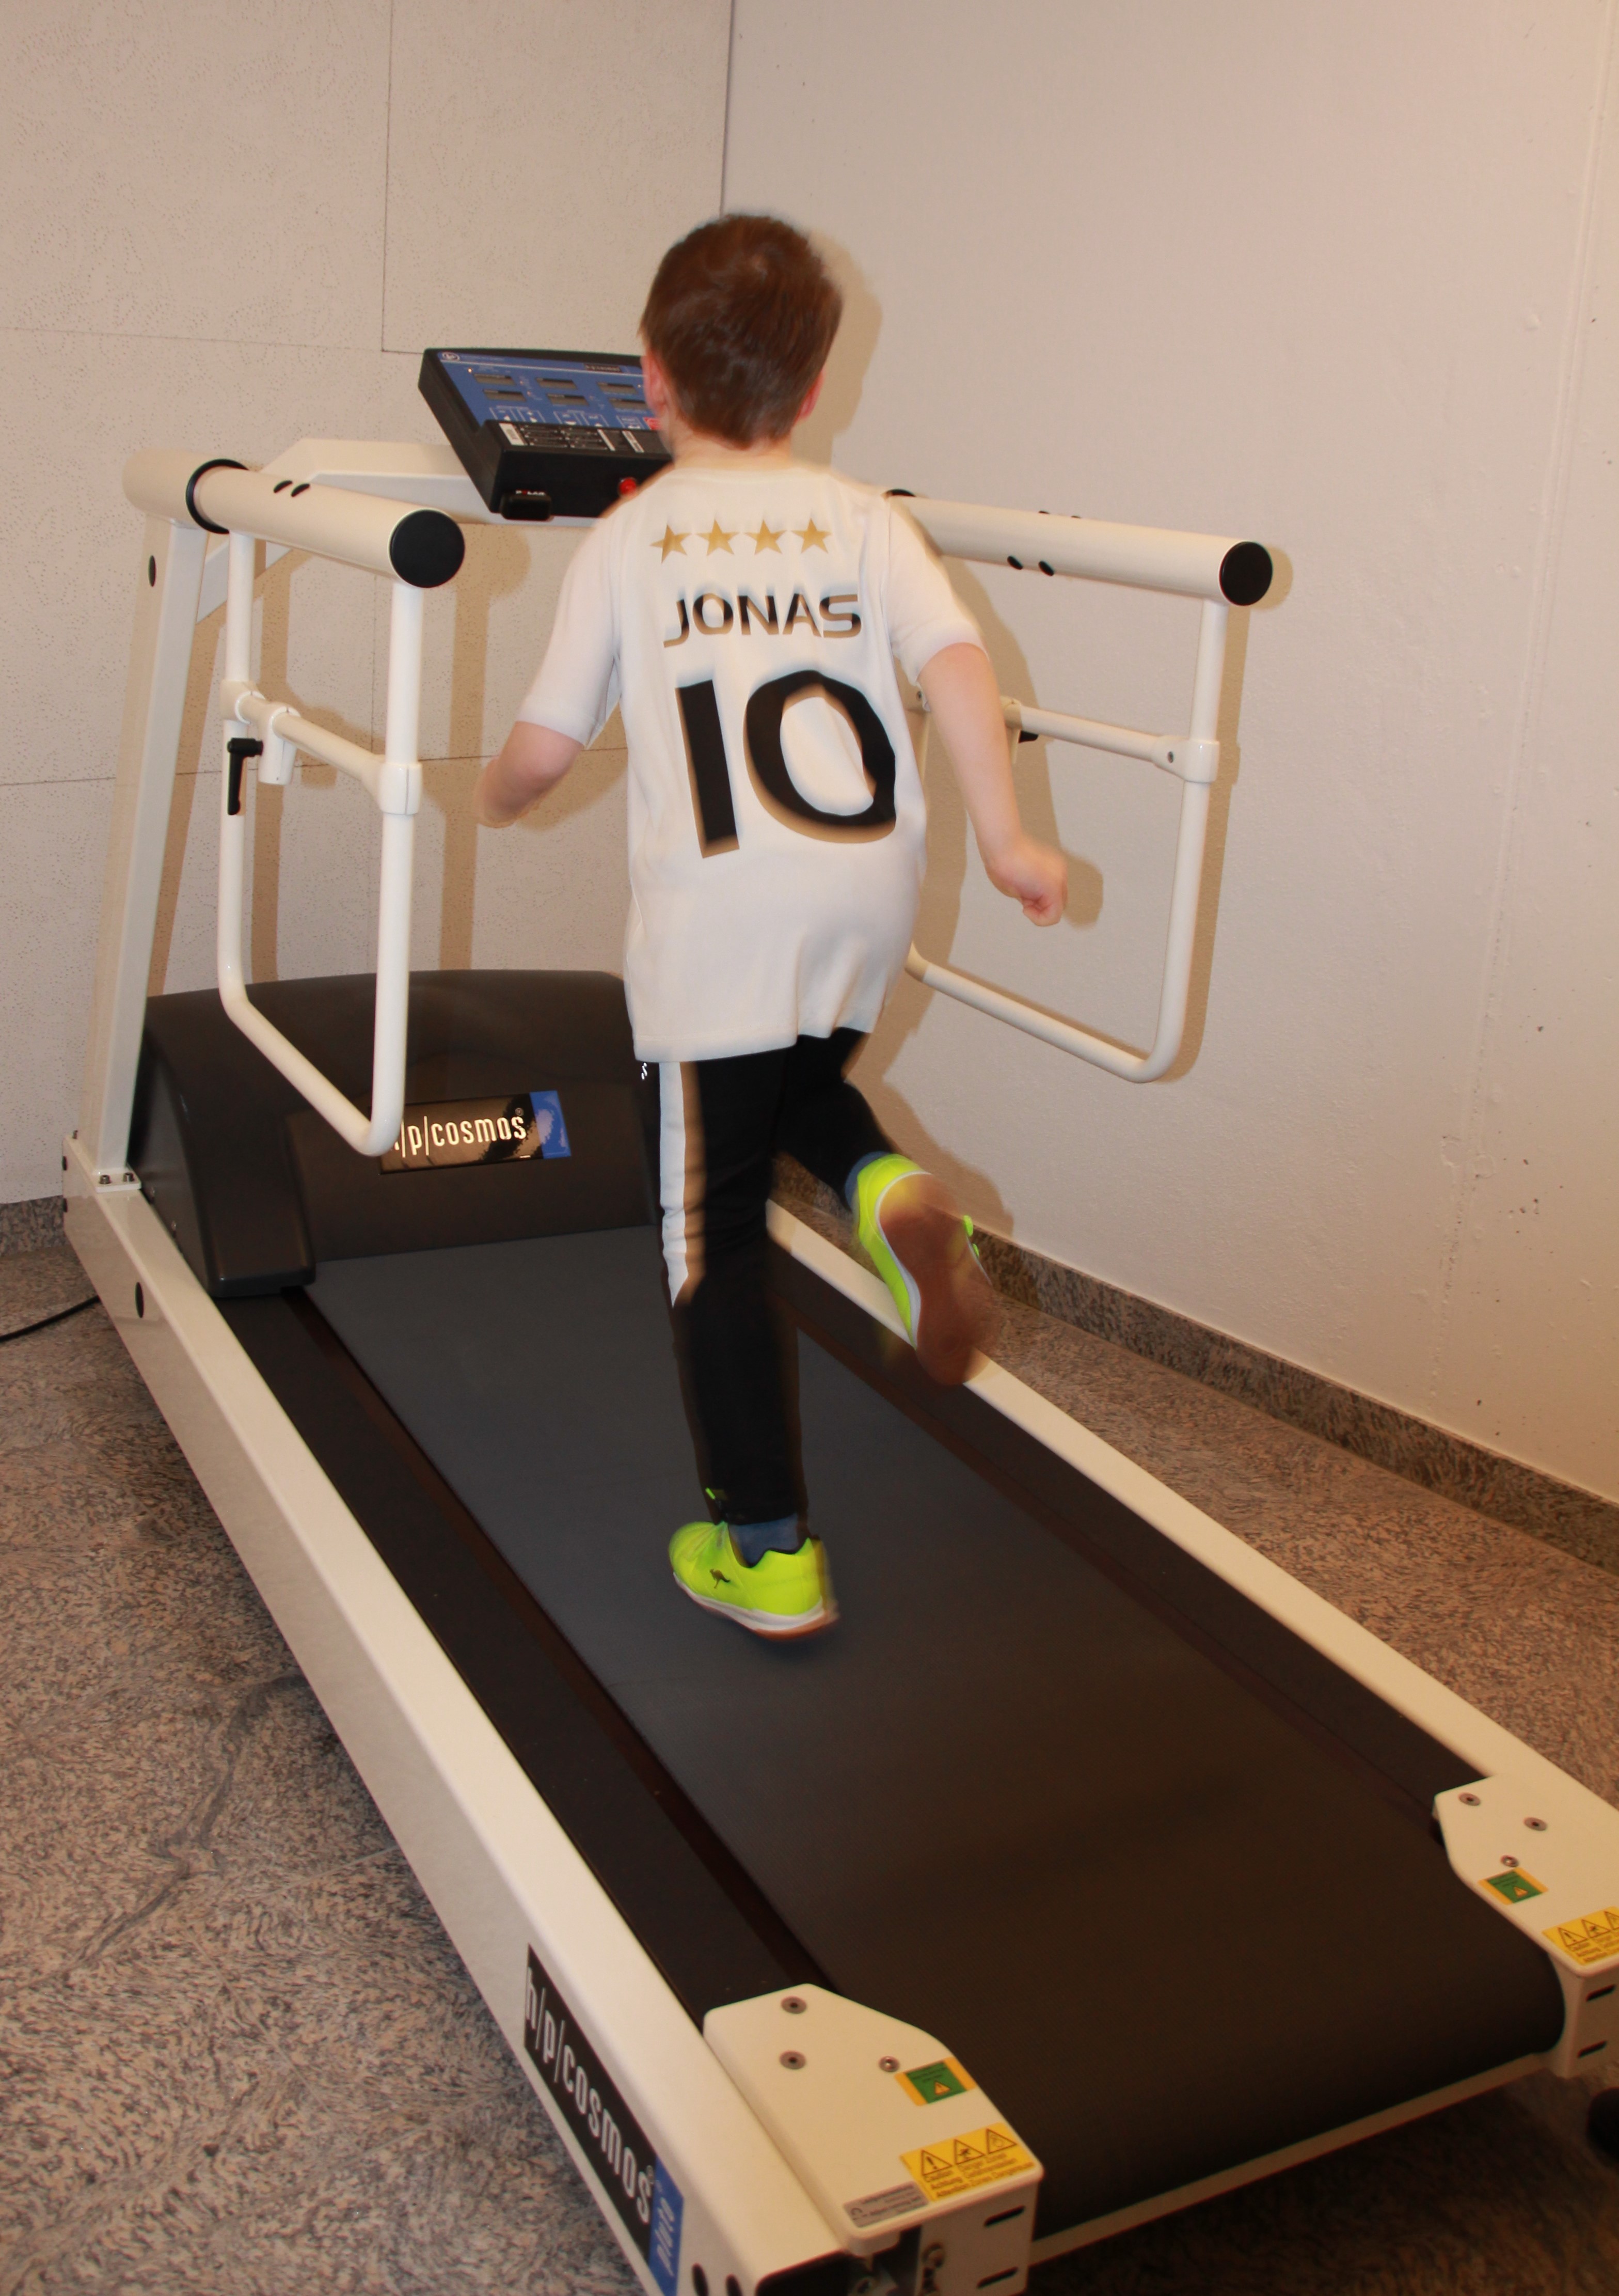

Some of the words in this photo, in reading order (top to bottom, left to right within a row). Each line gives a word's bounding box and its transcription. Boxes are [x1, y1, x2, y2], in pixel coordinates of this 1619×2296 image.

[663, 592, 862, 649] JONAS
[674, 669, 897, 859] 10
[393, 1115, 527, 1158] /p/cosmos
